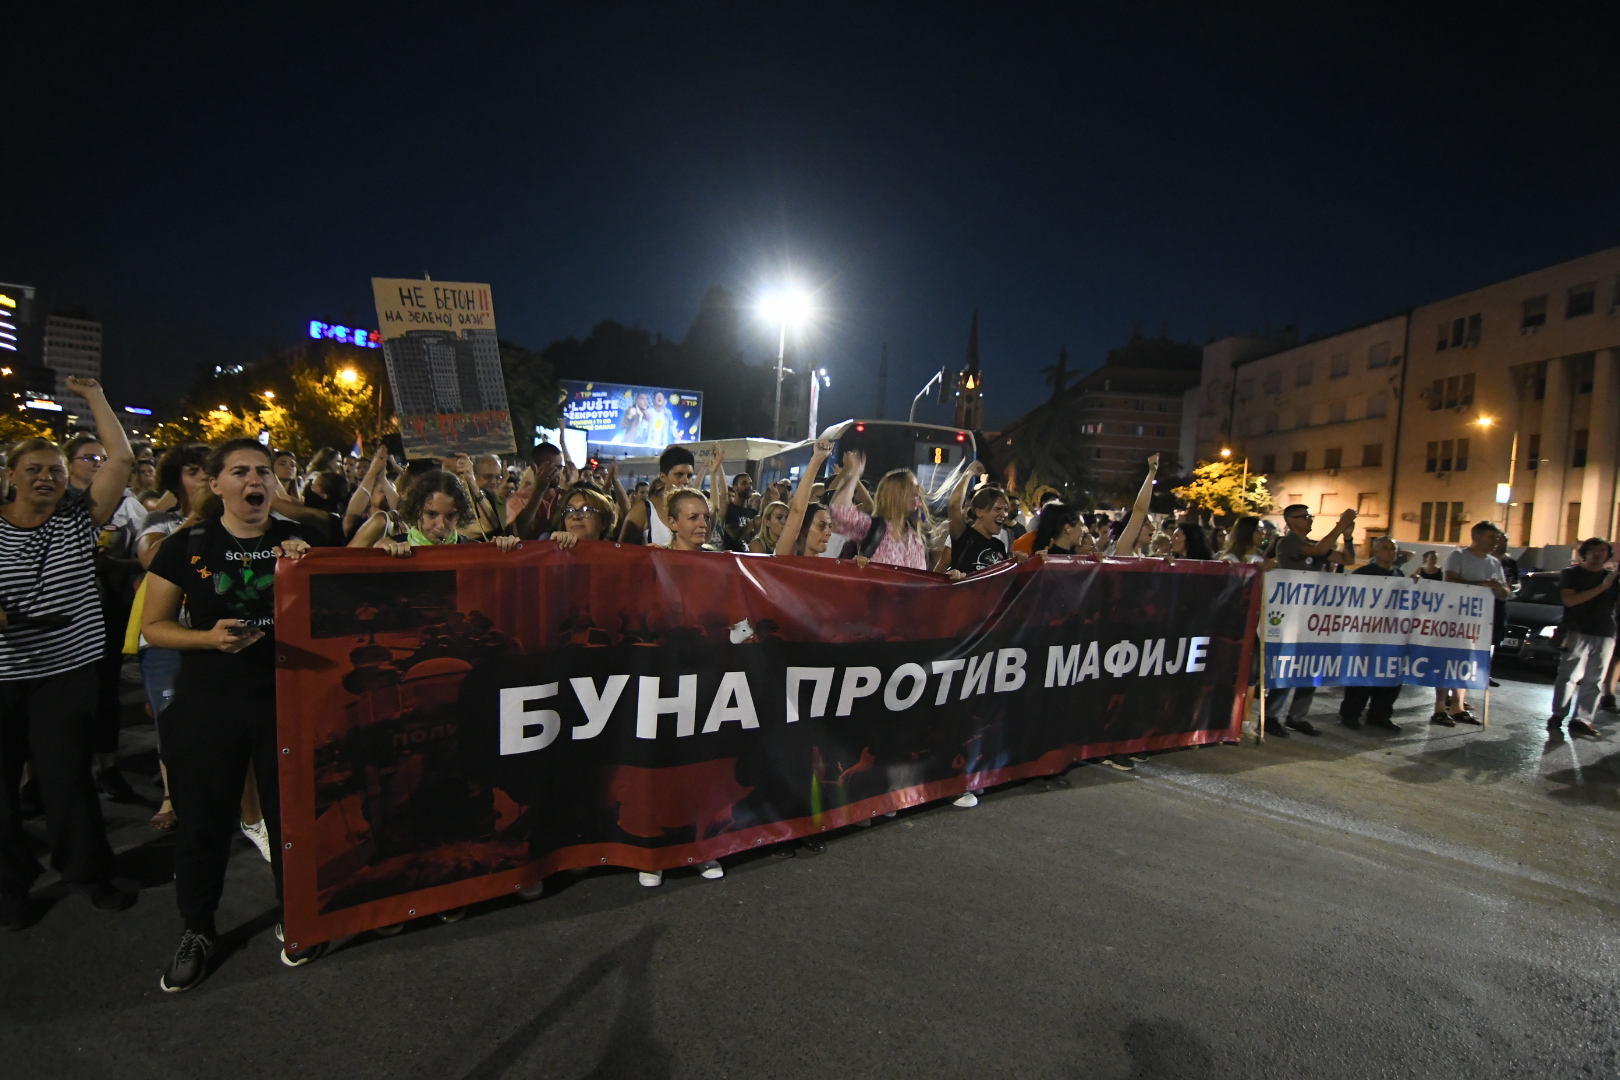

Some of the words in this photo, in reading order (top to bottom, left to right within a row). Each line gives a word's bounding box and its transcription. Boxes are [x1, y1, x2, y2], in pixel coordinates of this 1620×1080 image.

[398, 286, 427, 309] НЕ
[384, 310, 404, 322] НА
[1268, 581, 1367, 608] ЛИТИЈУМ
[1369, 587, 1383, 609] У
[1384, 588, 1445, 613] ЛЕВЧУ
[1458, 595, 1483, 617] НЕ!
[1268, 655, 1343, 680] ITHIUM
[1346, 655, 1369, 678] IN
[1444, 659, 1478, 682] NO!
[499, 670, 760, 756] БУНА
[785, 646, 1028, 724] ПРОТИВ
[1043, 636, 1211, 689] МАФИЈЕ
